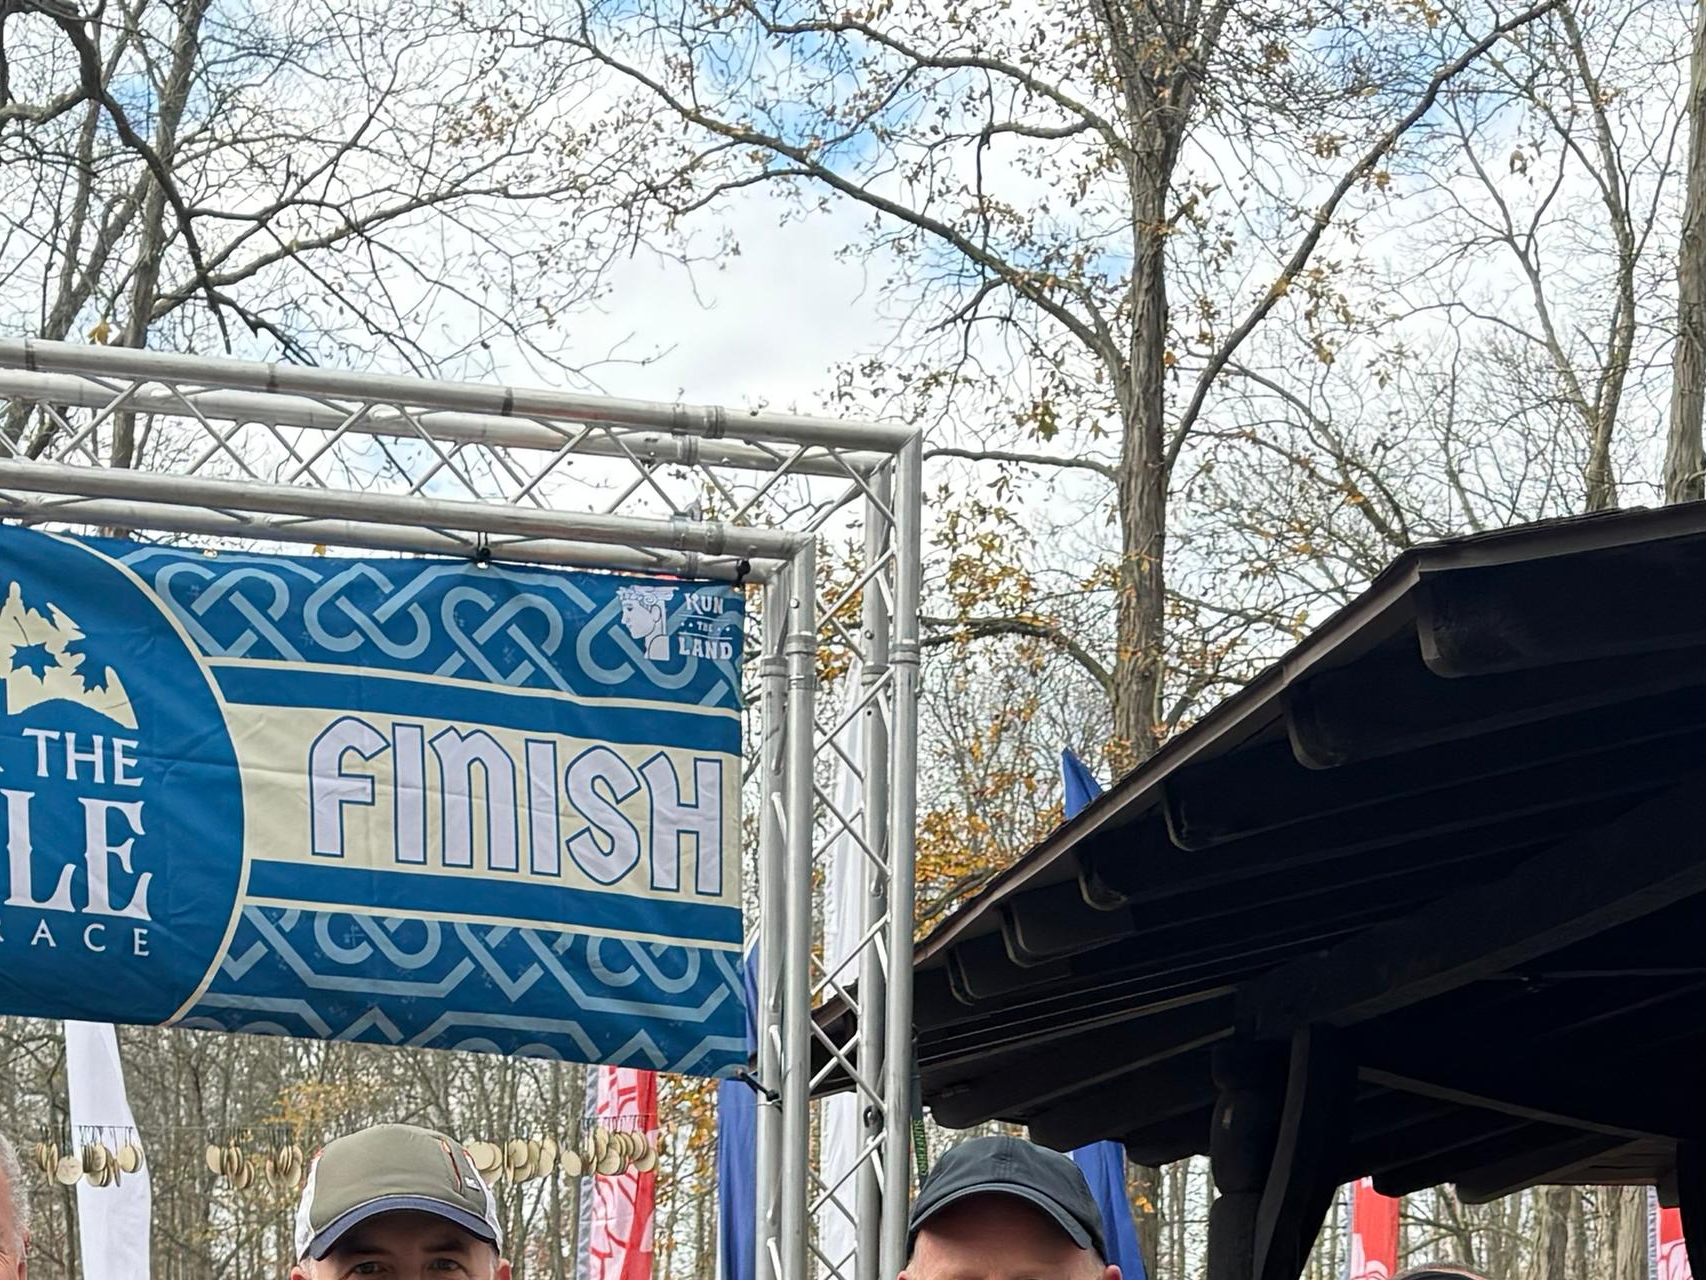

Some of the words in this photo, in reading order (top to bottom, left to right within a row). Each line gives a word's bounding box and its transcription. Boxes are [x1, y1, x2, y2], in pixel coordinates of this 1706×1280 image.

[684, 592, 723, 615] RUN
[697, 621, 713, 632] THE
[678, 636, 733, 660] LAND
[21, 726, 145, 787] THE
[307, 714, 724, 898] FINISH
